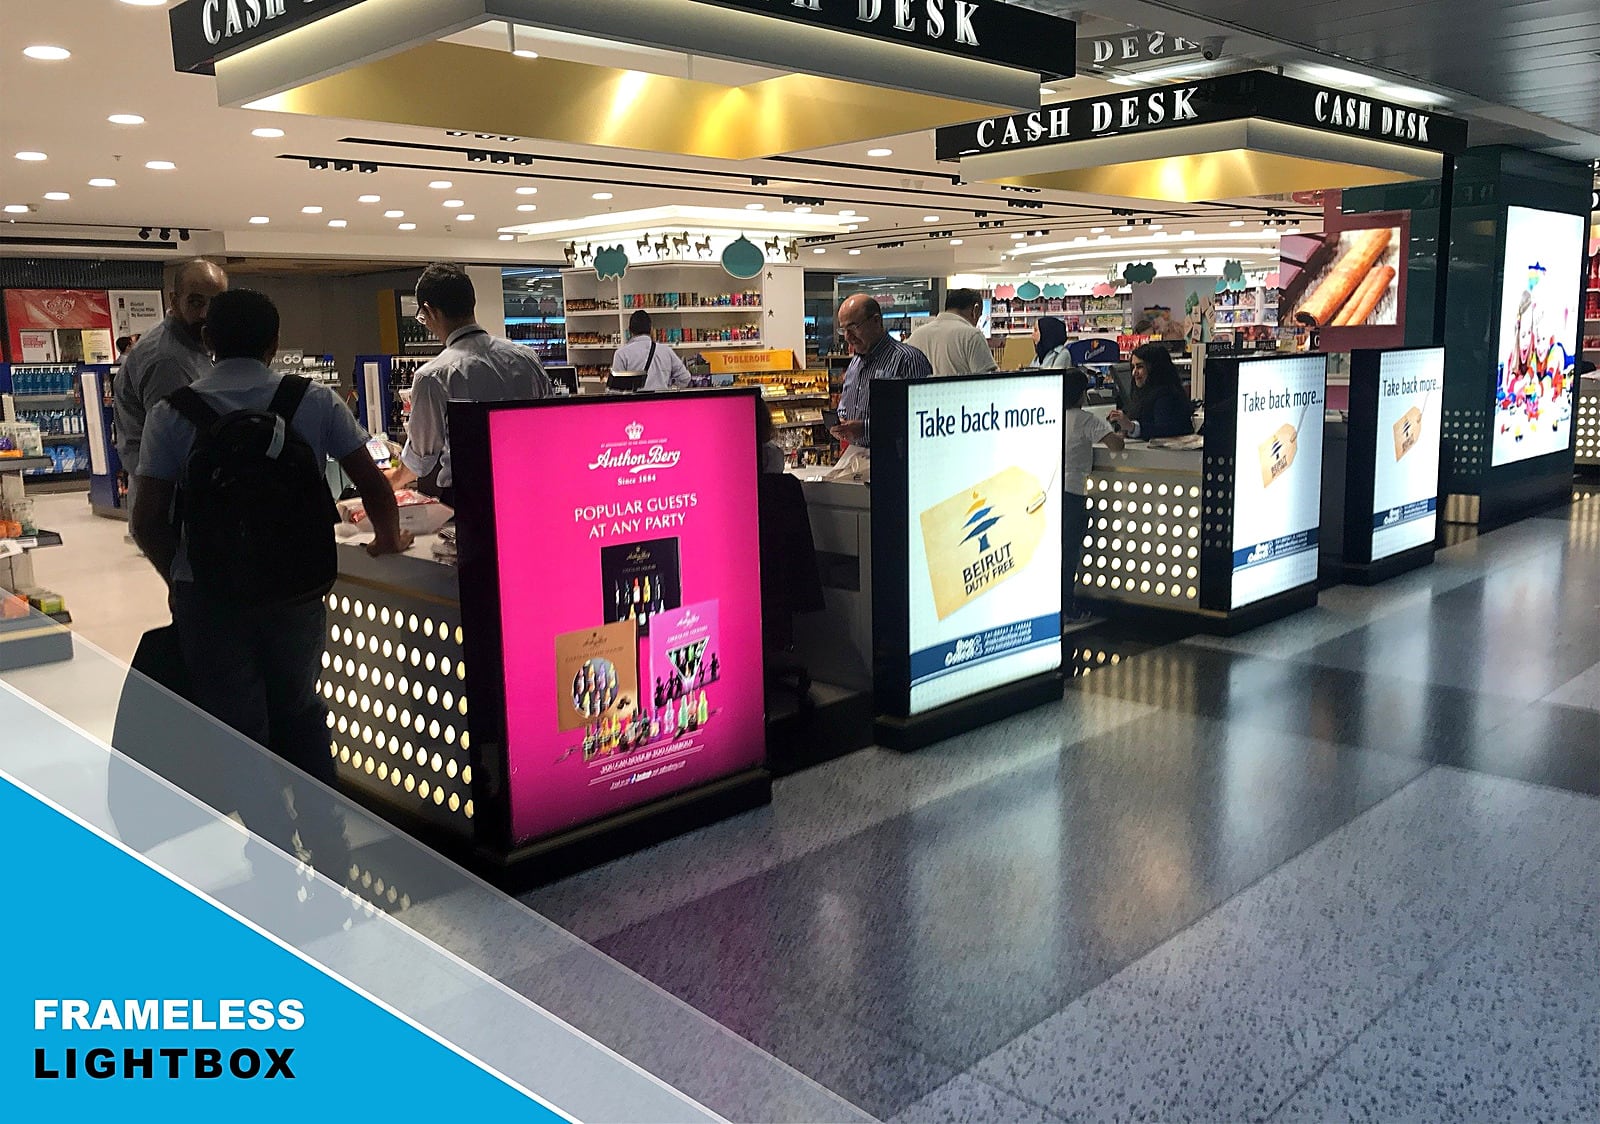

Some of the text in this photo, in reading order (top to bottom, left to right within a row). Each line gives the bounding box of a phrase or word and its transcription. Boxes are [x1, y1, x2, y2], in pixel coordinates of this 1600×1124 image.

[976, 86, 1199, 148] CASH DESK
[1314, 91, 1430, 142] CASH DESK
[722, 354, 771, 365] TOBLERONE
[1242, 388, 1323, 413] Take back more...
[1382, 376, 1442, 398] Take back more...
[915, 402, 1056, 438] Take back more...
[588, 445, 681, 470] Anthon Berg
[617, 477, 636, 487] Since
[574, 492, 698, 523] POPULAR GUESTS
[589, 512, 686, 540] AT ANY PARTY
[962, 541, 1013, 584] BEIRUT
[965, 556, 1015, 597] DUTY FREE
